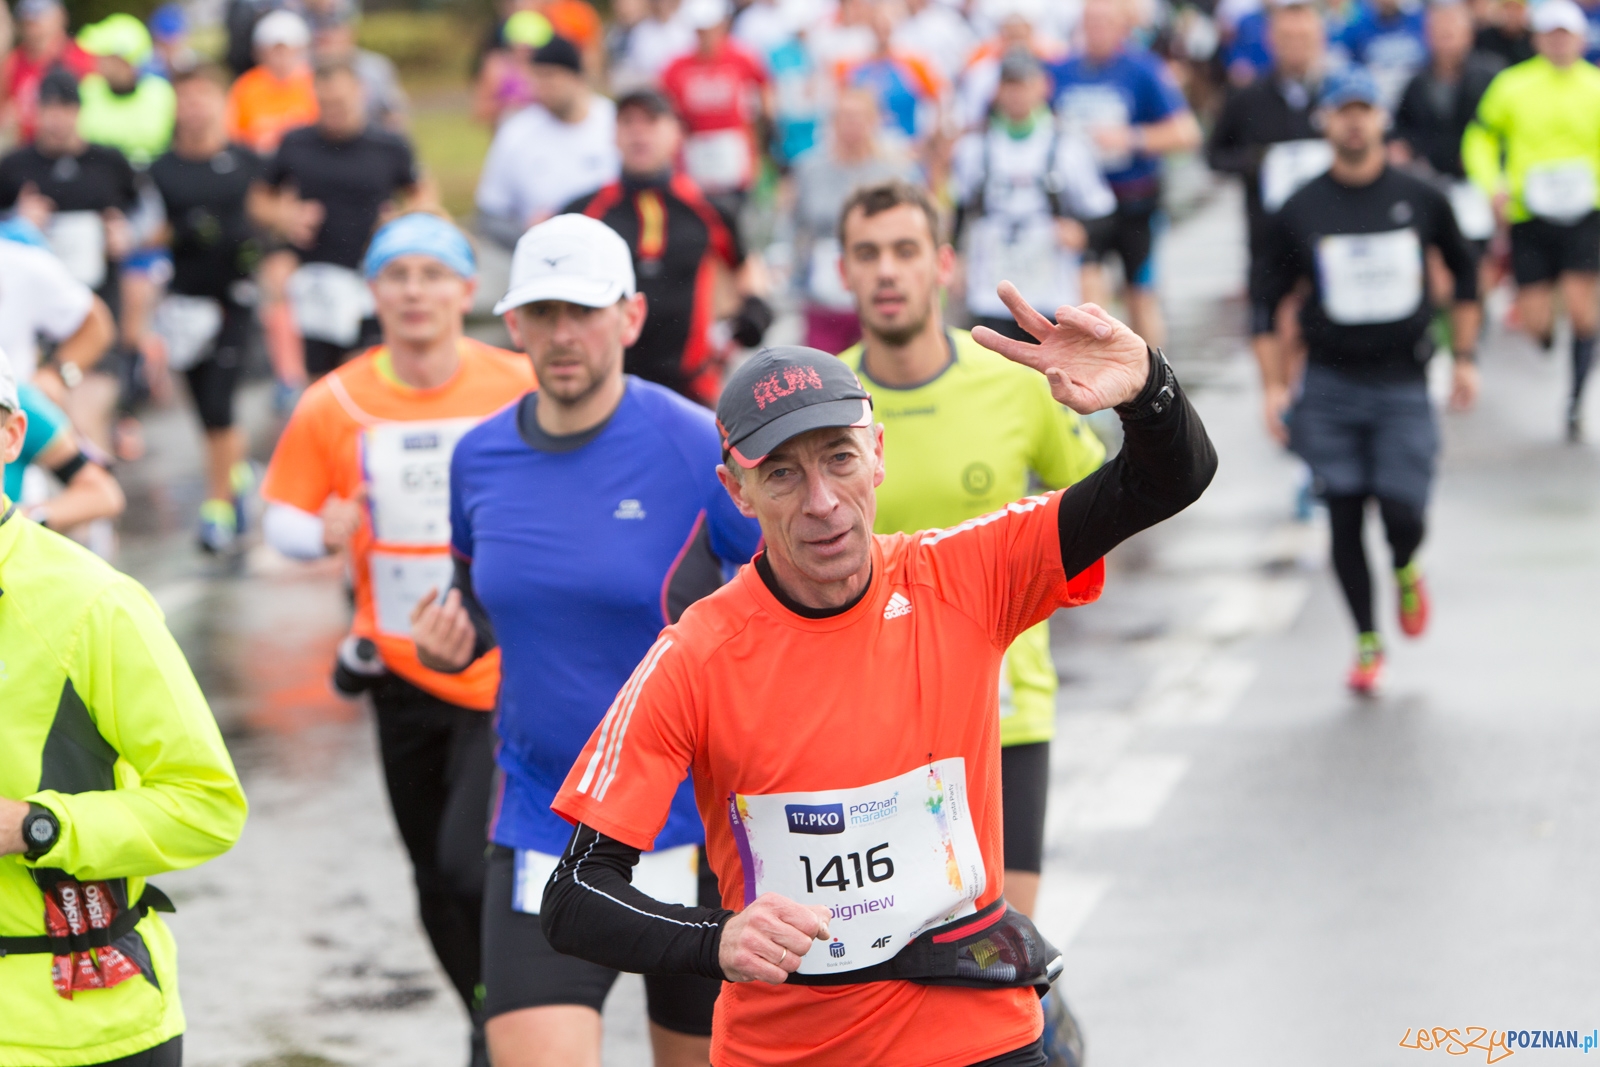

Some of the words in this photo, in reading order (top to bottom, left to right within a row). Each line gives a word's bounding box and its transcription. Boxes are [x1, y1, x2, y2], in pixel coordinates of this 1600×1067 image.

[752, 365, 823, 411] RUN
[850, 805, 897, 825] maraton
[799, 842, 894, 893] 1416
